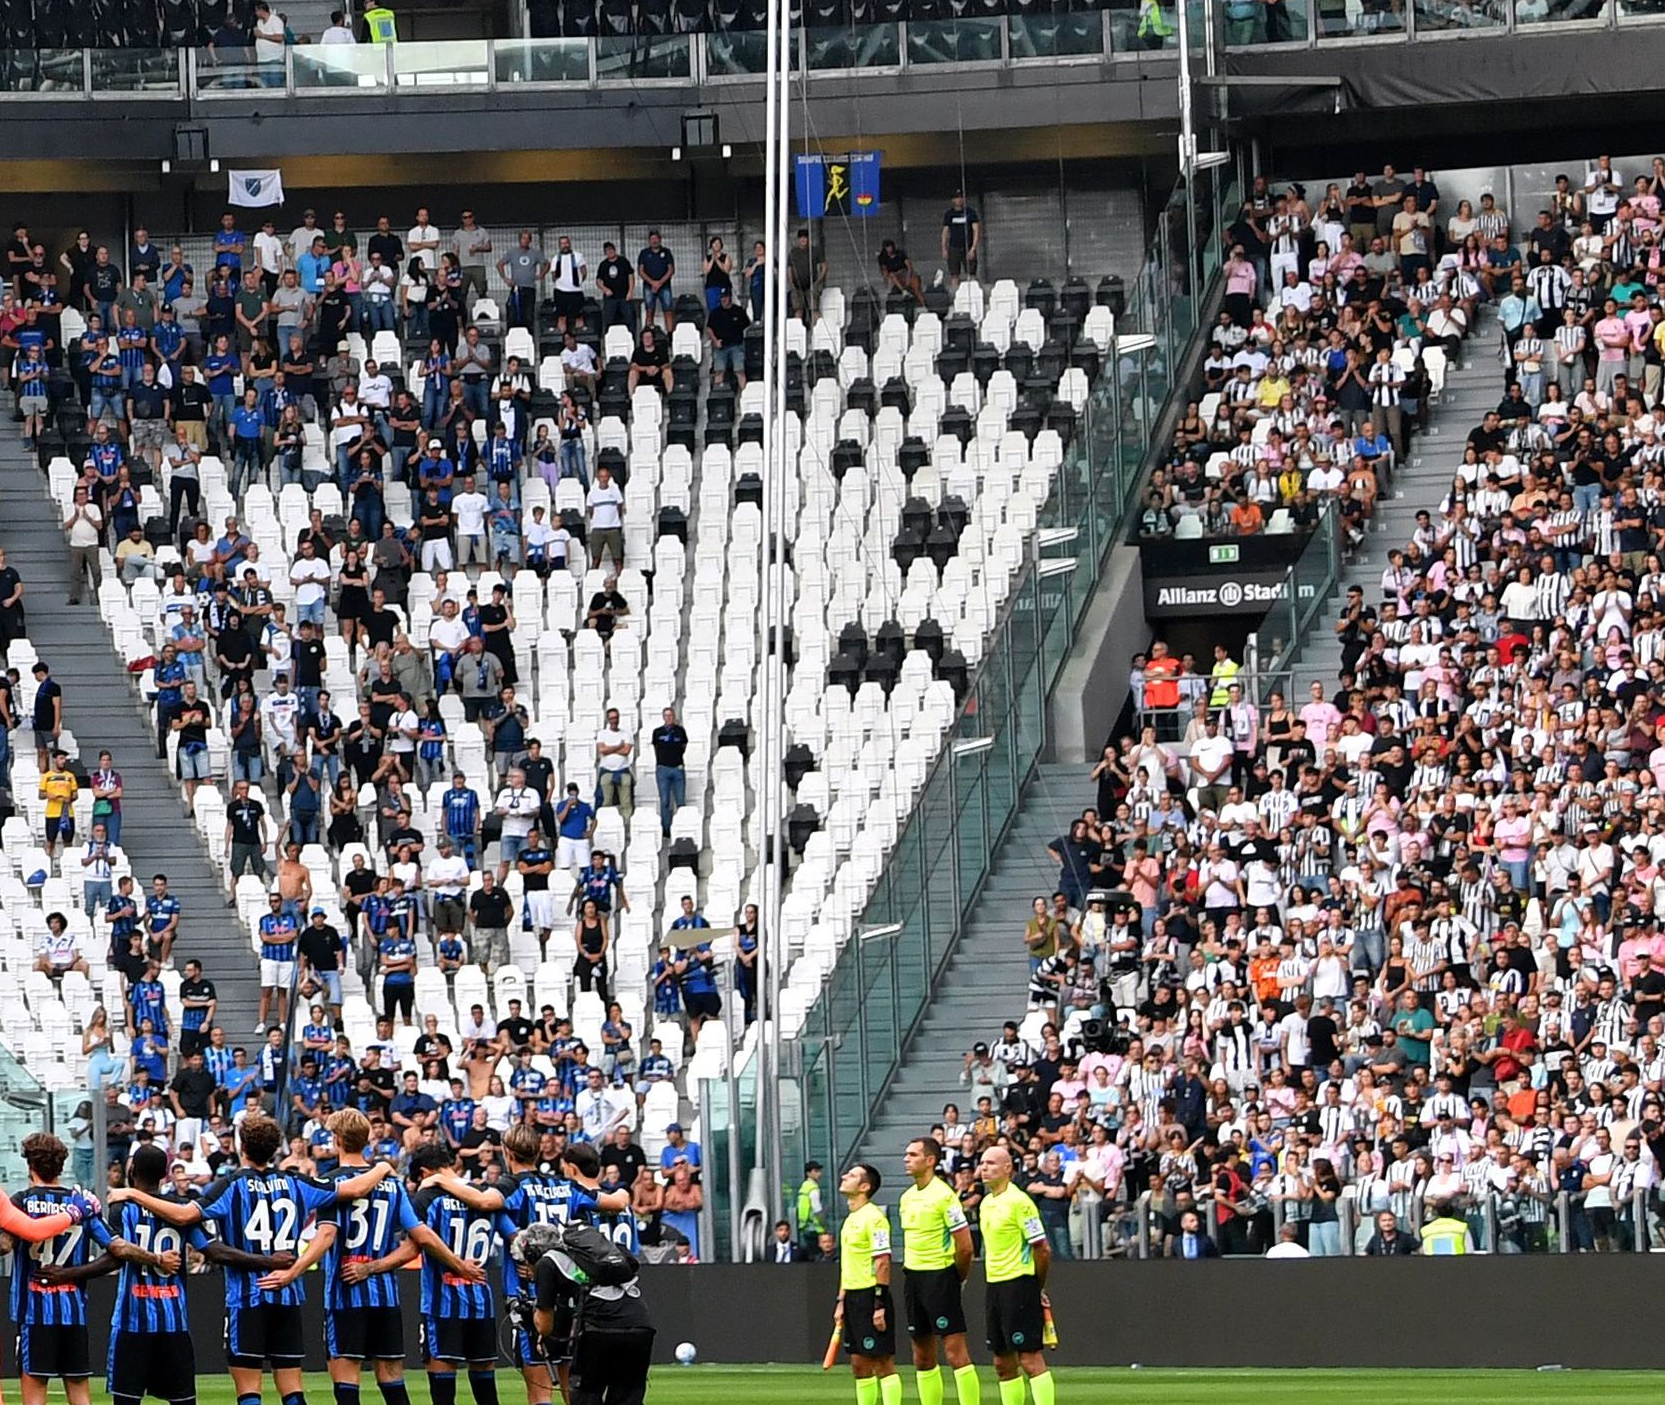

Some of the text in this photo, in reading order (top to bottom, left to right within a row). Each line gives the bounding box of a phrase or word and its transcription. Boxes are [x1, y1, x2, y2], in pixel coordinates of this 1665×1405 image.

[1157, 582, 1315, 606] Allianz Stadim
[247, 1178, 290, 1194] SCALVINI
[244, 1198, 297, 1251] 42
[345, 1198, 389, 1251] 31
[450, 1217, 493, 1268] 16
[131, 1284, 179, 1298] GEWISS
